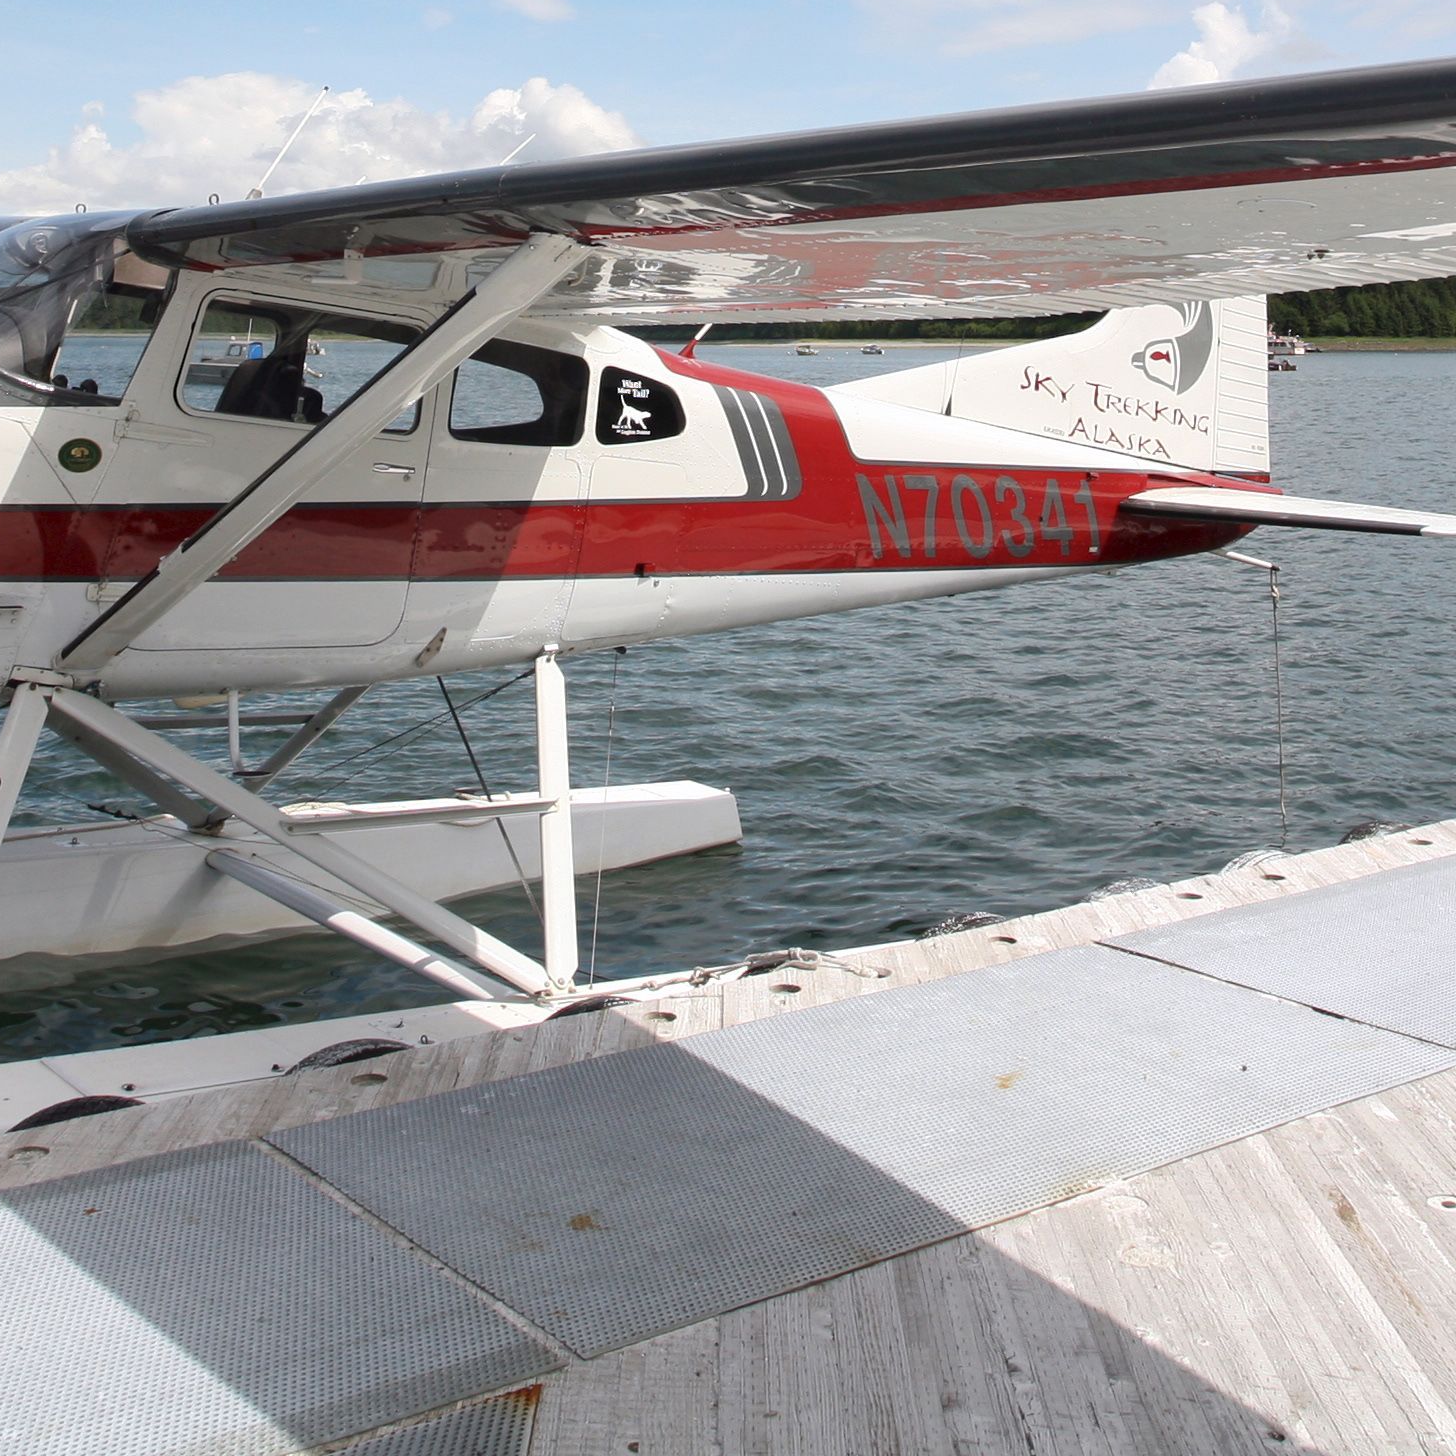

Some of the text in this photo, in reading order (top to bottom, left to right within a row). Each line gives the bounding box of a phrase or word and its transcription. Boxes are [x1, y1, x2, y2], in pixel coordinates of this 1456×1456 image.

[1020, 365, 1210, 436] SKY TREKKING
[1068, 417, 1171, 459] ALASKA
[855, 473, 1101, 559] N70341
